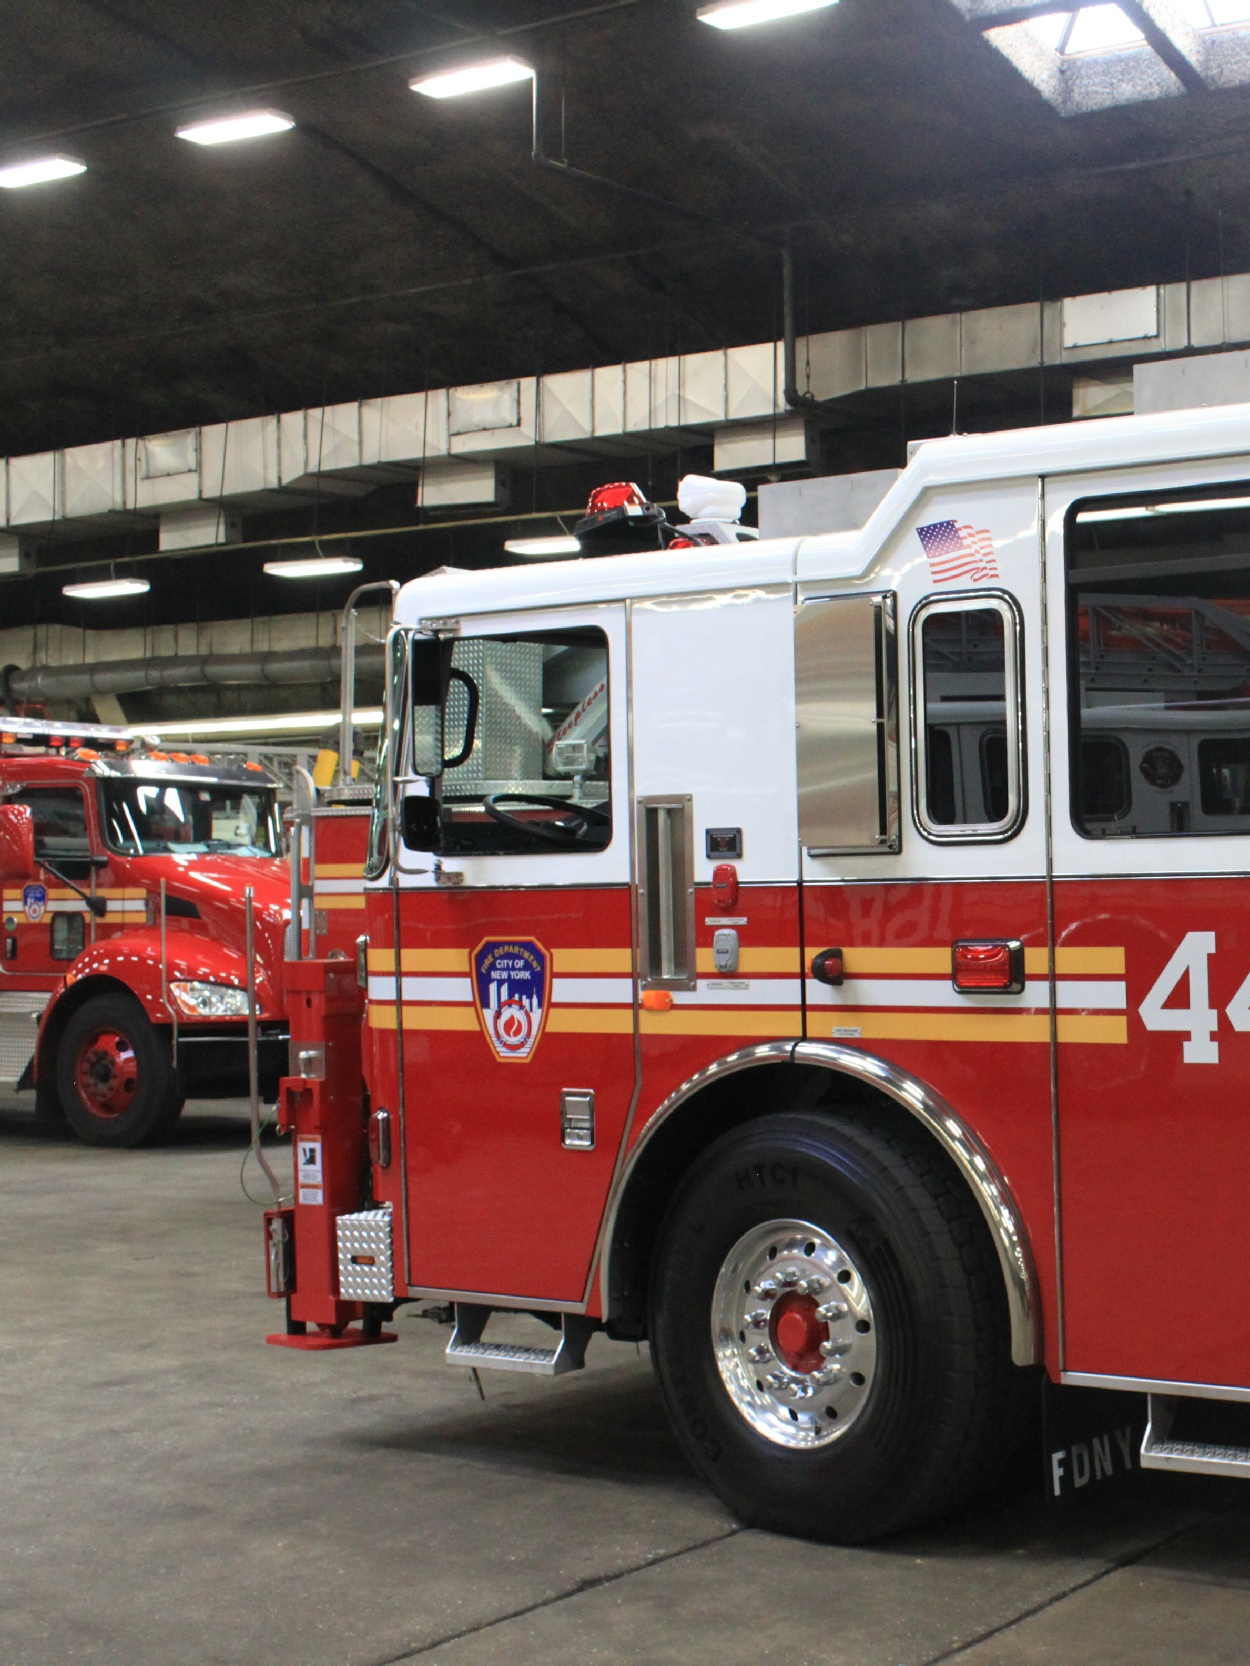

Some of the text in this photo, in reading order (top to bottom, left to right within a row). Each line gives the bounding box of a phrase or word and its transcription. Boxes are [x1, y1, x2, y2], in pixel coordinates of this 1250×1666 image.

[481, 944, 542, 974] FIRE DEPARTMENT
[495, 959, 525, 969] CITY OF
[491, 970, 531, 980] NEW YORK
[1052, 1426, 1132, 1497] FDNY
